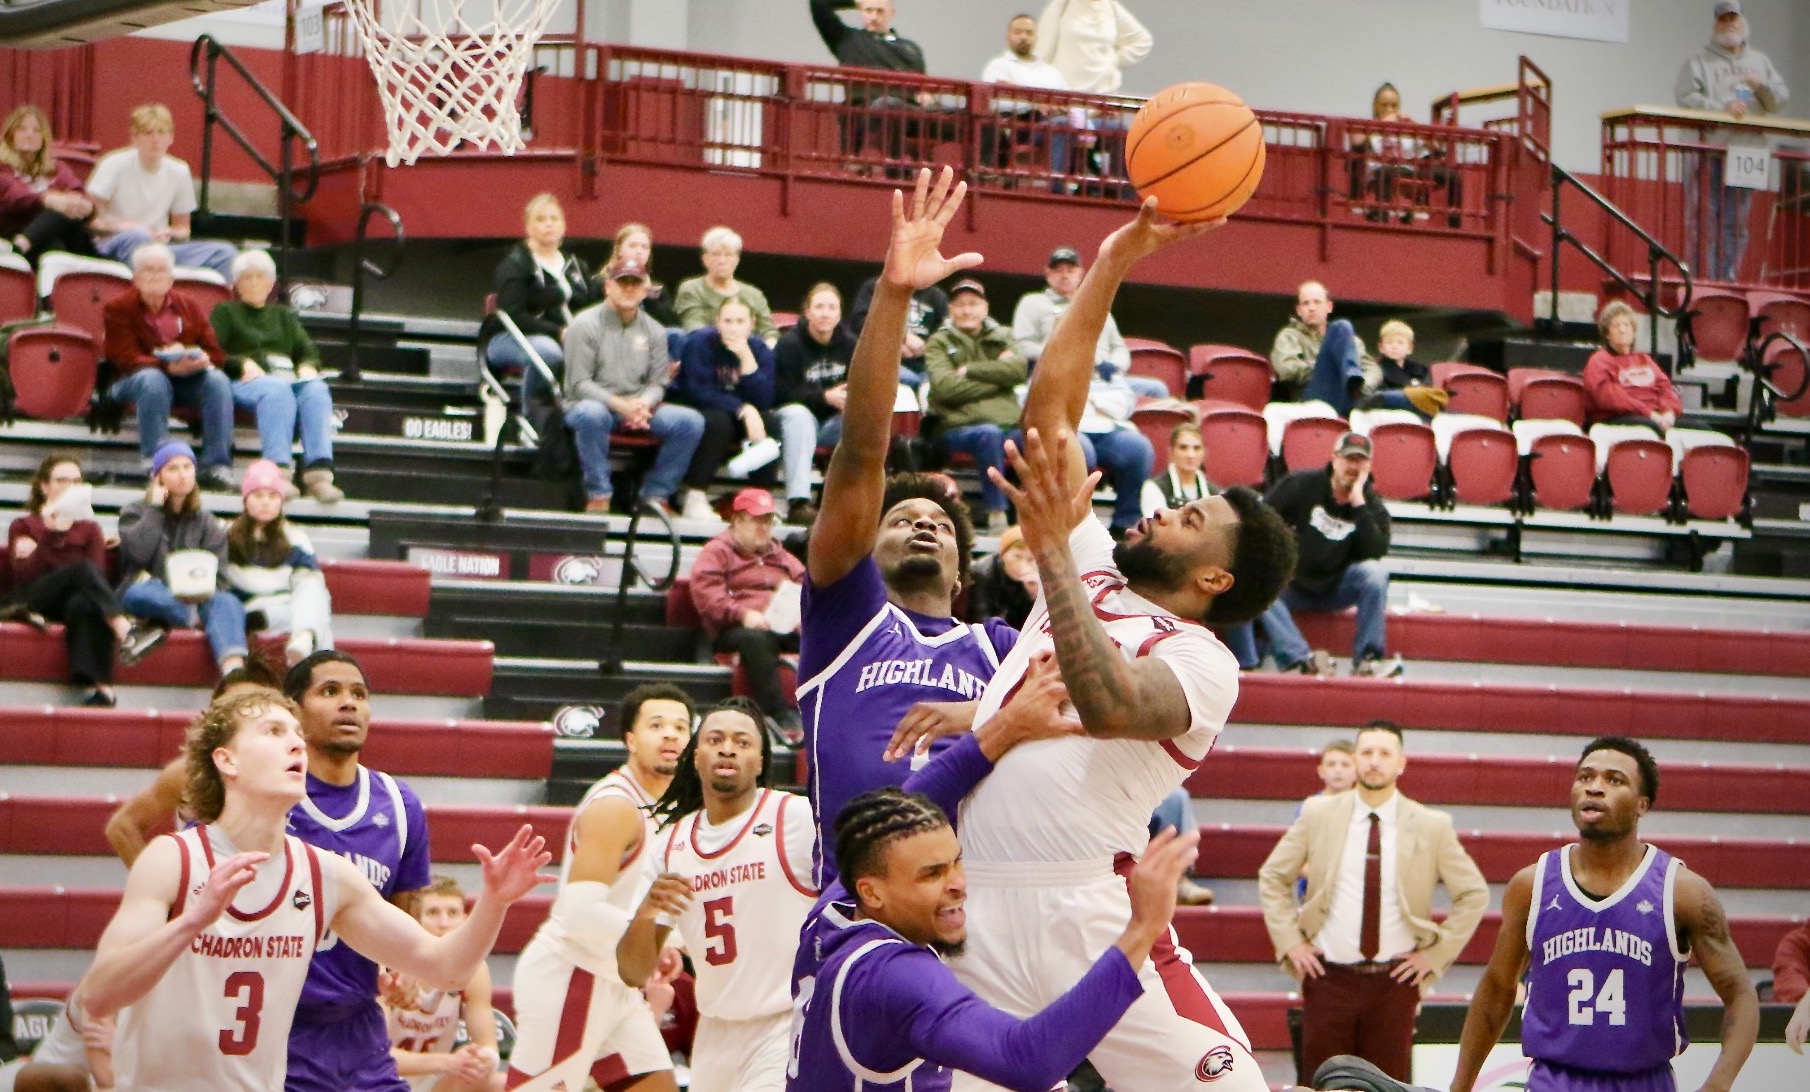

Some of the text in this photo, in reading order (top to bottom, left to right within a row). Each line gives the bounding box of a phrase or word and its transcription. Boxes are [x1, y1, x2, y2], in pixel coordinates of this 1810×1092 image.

[301, 14, 320, 37] 103
[1736, 155, 1765, 175] 104
[405, 417, 472, 440] GO EAGLES!
[421, 554, 500, 576] EAGLE NATION
[856, 659, 988, 701] HIGHLAND
[691, 862, 765, 892] DRON STATE
[191, 933, 263, 958] CHADRON
[267, 936, 304, 958] STATE
[704, 896, 737, 966] 5
[1543, 927, 1652, 967] HIGHLANDS
[1567, 968, 1626, 1026] 24
[219, 972, 264, 1055] 3
